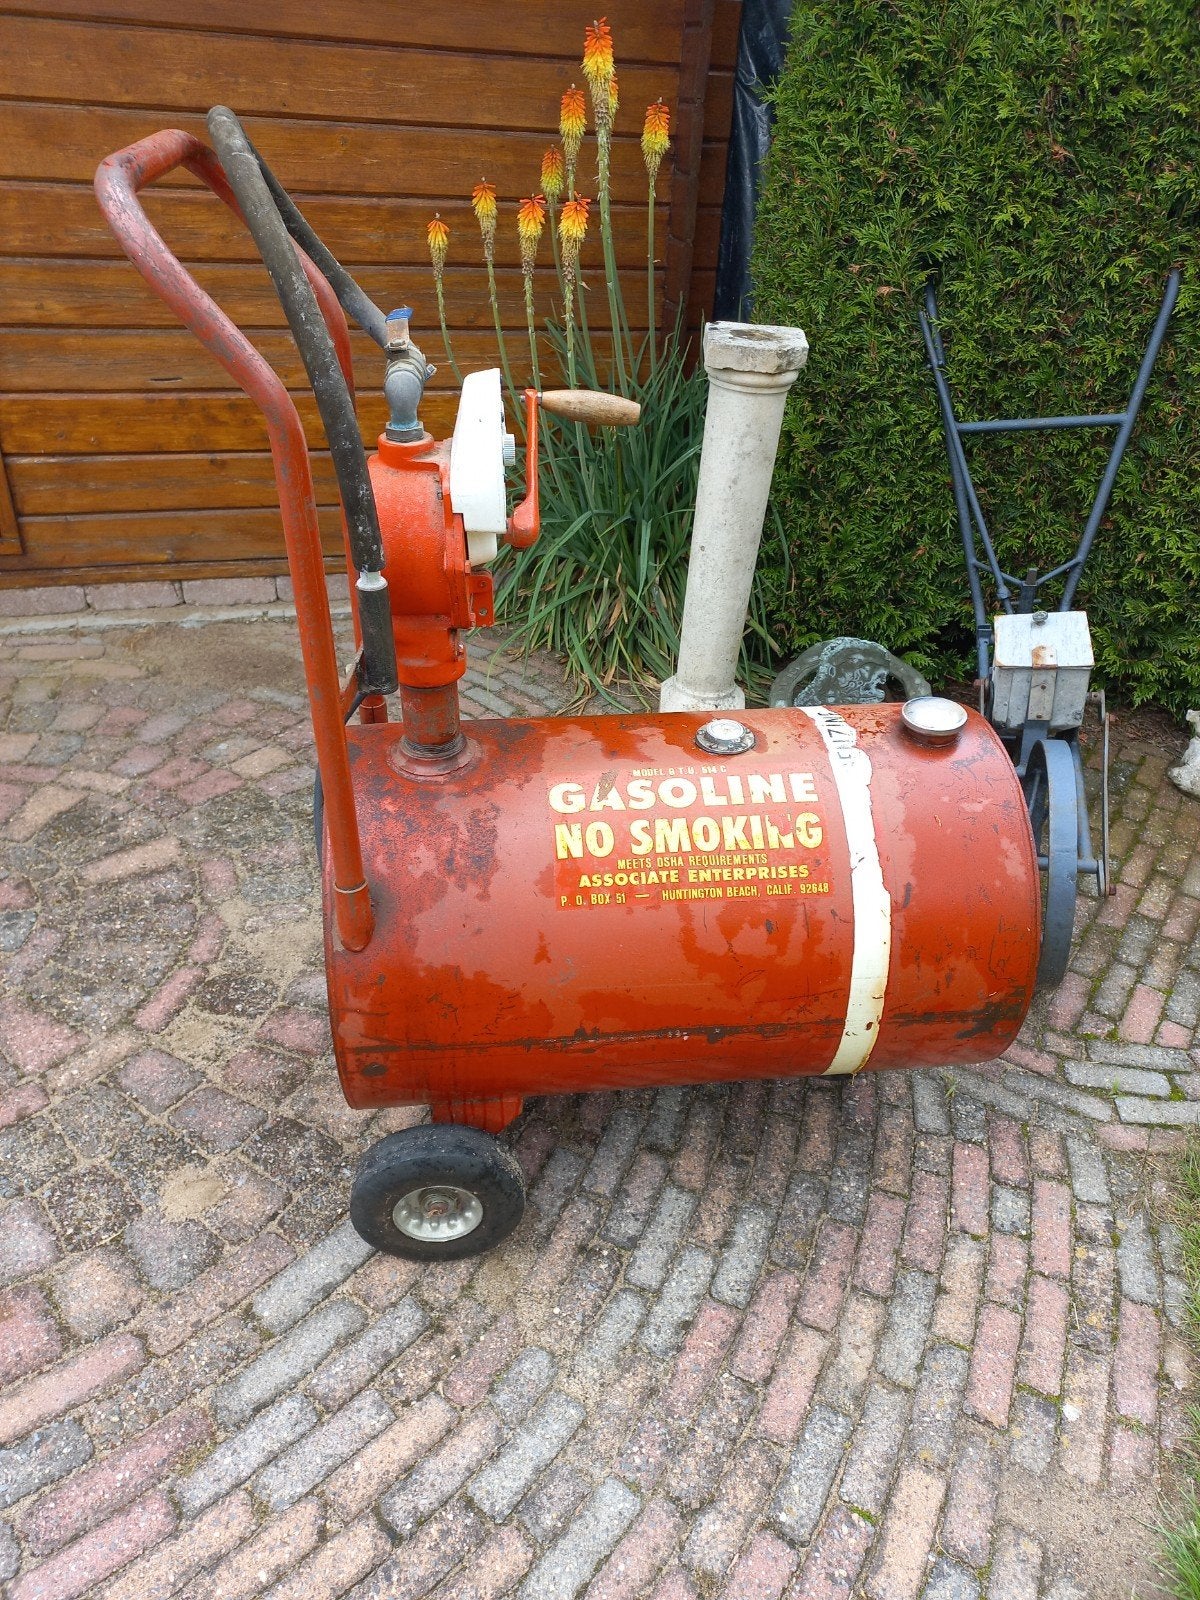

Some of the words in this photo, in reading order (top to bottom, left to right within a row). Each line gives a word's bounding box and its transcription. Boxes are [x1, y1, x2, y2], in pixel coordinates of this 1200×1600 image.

[632, 767, 666, 777] MODEL
[548, 772, 818, 814] GASOLINE
[554, 820, 615, 860] NO
[629, 811, 824, 855] SMOKING
[617, 857, 652, 870] MEETS
[656, 855, 684, 868] OSHA
[688, 853, 768, 867] REQUIREMENTS
[579, 869, 680, 888] ASSOCIATE
[687, 864, 810, 883] ENTERPRISES
[590, 893, 611, 905] BOX
[615, 892, 627, 904] 51
[661, 887, 723, 901] HUNTINGTON
[726, 885, 761, 898] BEACH,
[766, 883, 797, 896] CALIF.
[800, 882, 830, 894] 92648
